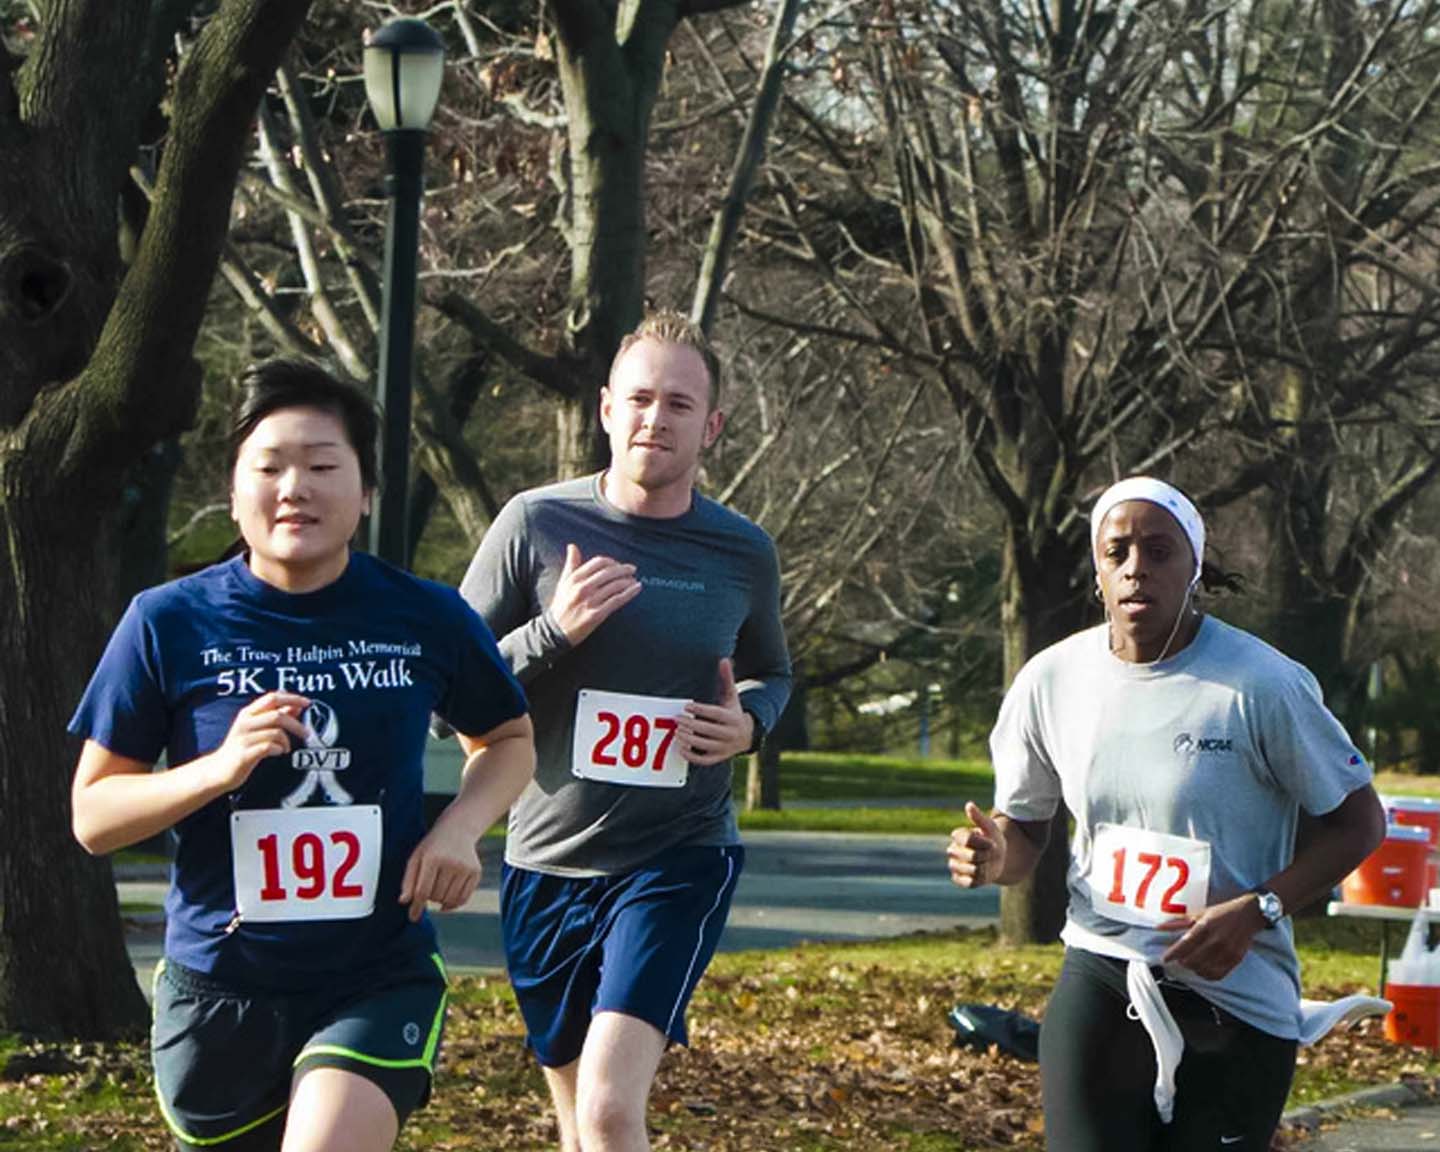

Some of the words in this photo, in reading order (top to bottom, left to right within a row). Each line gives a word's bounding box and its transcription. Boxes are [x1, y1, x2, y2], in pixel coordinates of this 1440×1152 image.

[201, 649, 231, 666] The
[237, 646, 282, 664] Tracy
[287, 645, 343, 664] Halpin
[348, 640, 422, 657] Memorial
[216, 666, 266, 696] 5K
[276, 666, 336, 693] Fun
[339, 658, 414, 690] Walk
[297, 751, 347, 768] DVT
[591, 711, 679, 771] 287
[1196, 738, 1233, 752] NCAA
[257, 830, 363, 902] 192
[1107, 847, 1190, 914] 172
